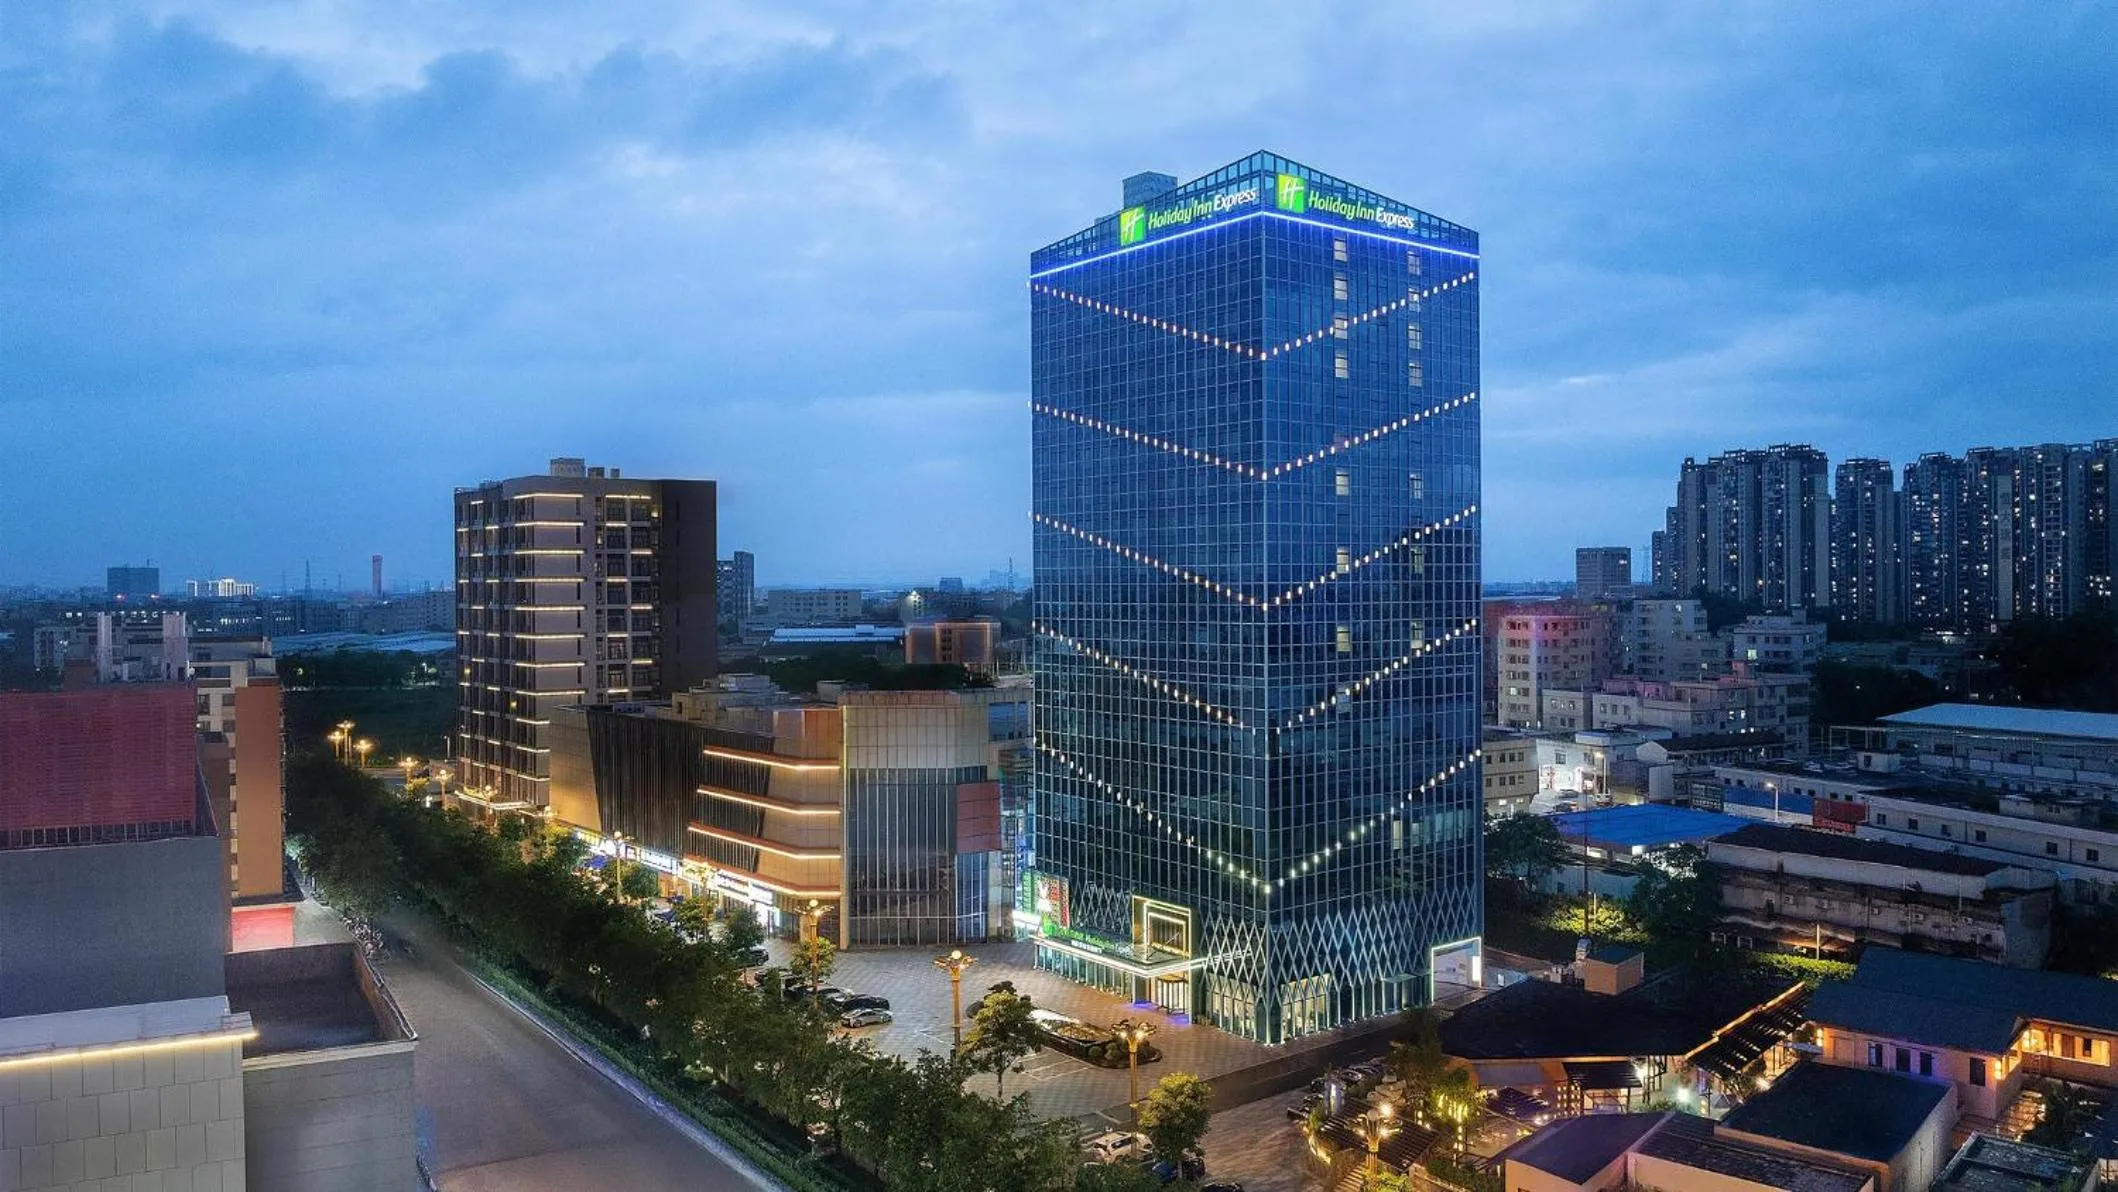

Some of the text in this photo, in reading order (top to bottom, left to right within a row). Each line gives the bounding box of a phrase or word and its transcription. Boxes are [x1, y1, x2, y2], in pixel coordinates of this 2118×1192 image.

[1148, 205, 1193, 230] Holiday
[1193, 199, 1212, 217] Inn
[1213, 188, 1257, 213] Express
[1309, 190, 1356, 220] Holiday
[1356, 202, 1374, 220] Inn
[1375, 207, 1414, 229] Express
